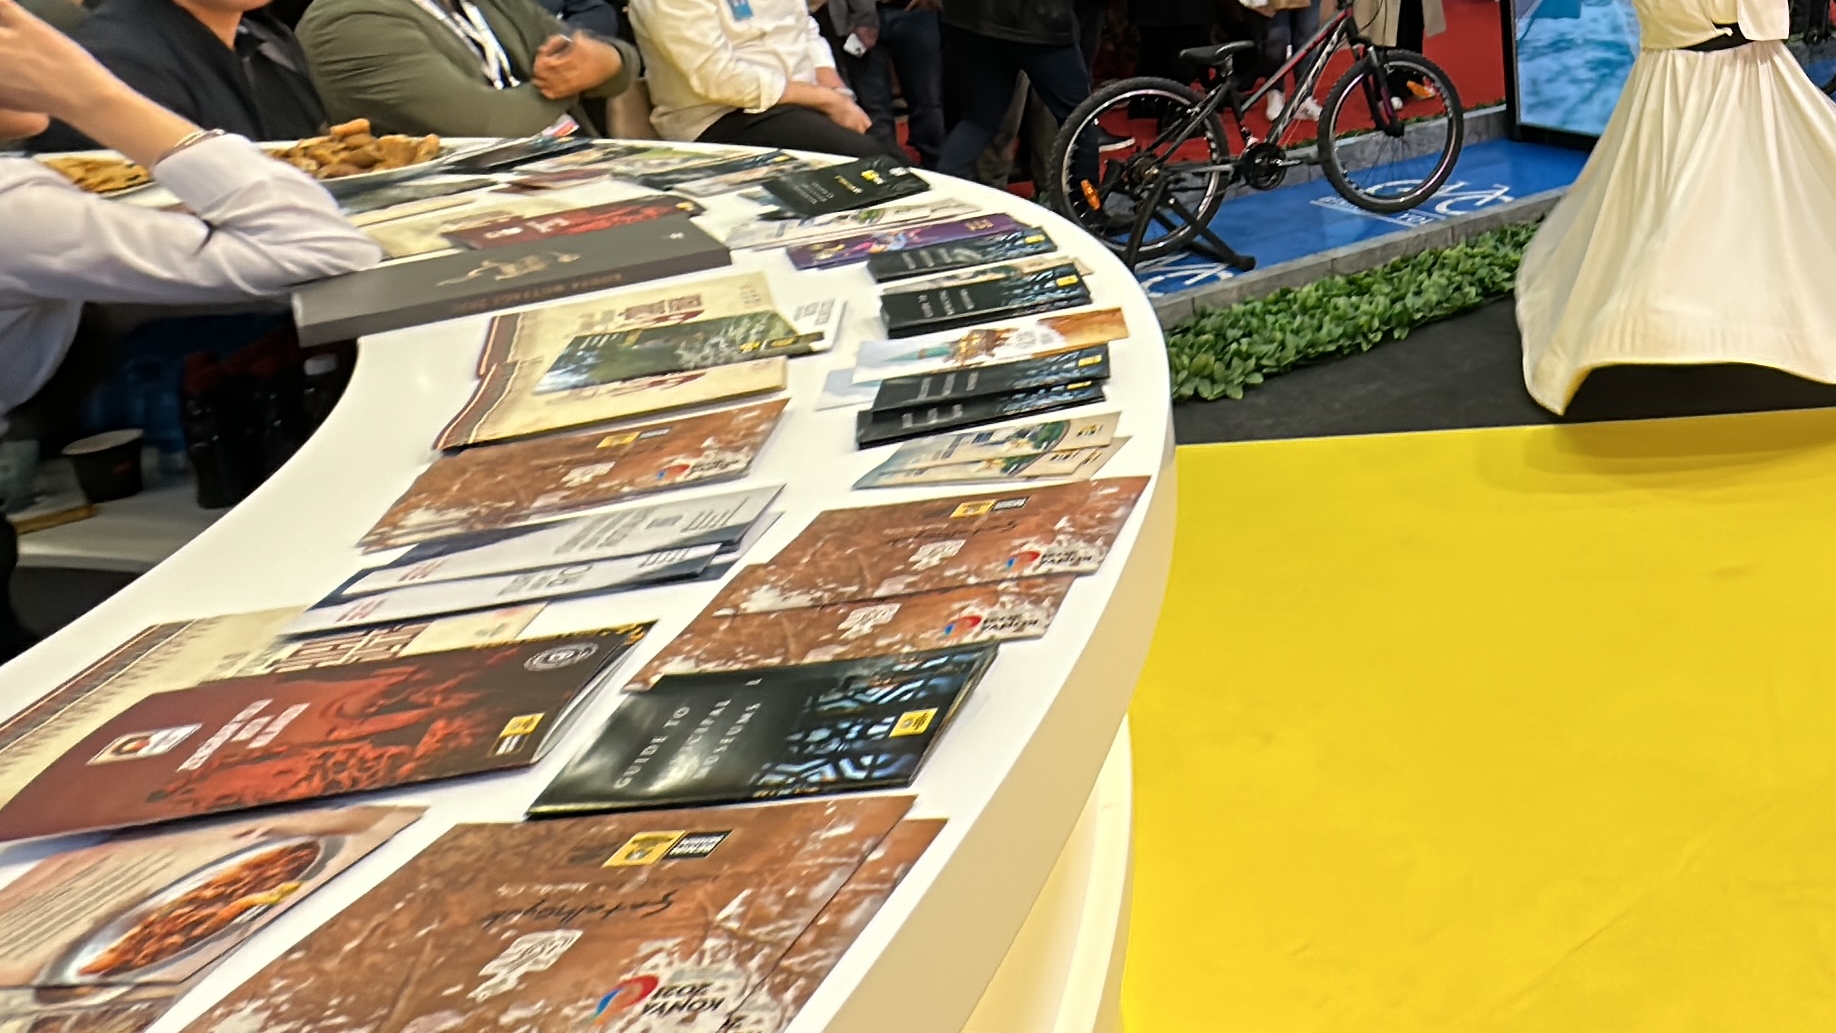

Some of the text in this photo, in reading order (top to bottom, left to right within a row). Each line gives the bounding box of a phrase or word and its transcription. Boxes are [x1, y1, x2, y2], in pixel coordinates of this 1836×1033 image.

[613, 706, 691, 789] GUIDE TO
[651, 982, 713, 999] 2021
[642, 997, 726, 1014] KONYA
